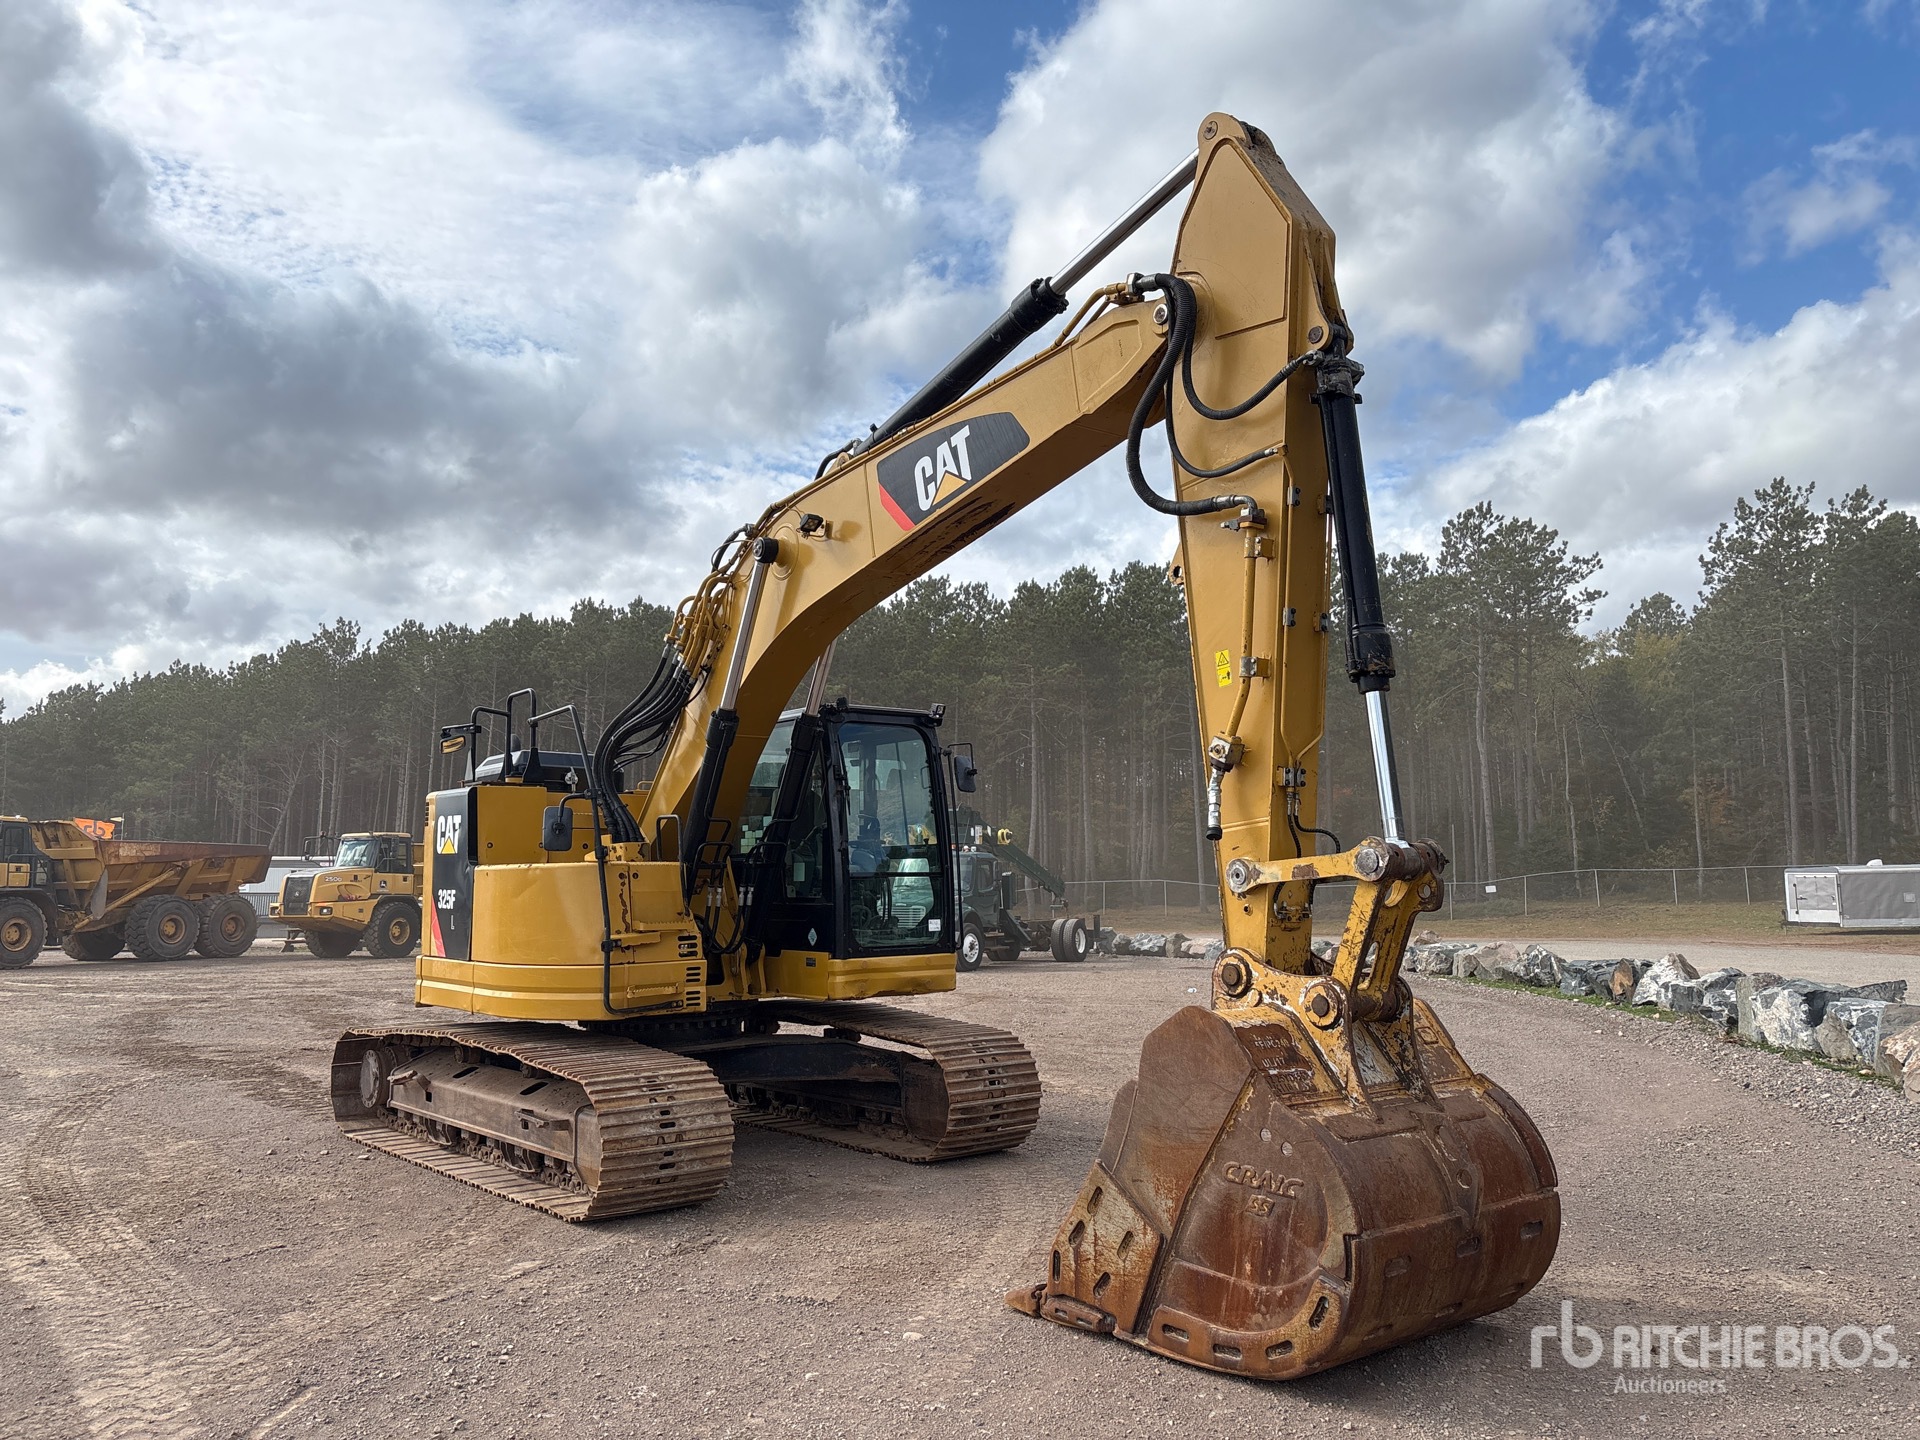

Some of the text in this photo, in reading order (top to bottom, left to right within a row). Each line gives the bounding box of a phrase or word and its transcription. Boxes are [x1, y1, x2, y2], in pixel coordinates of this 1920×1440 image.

[914, 425, 972, 511] CAT
[437, 815, 461, 854] CAT
[438, 889, 456, 909] 325F
[450, 915, 455, 930] L
